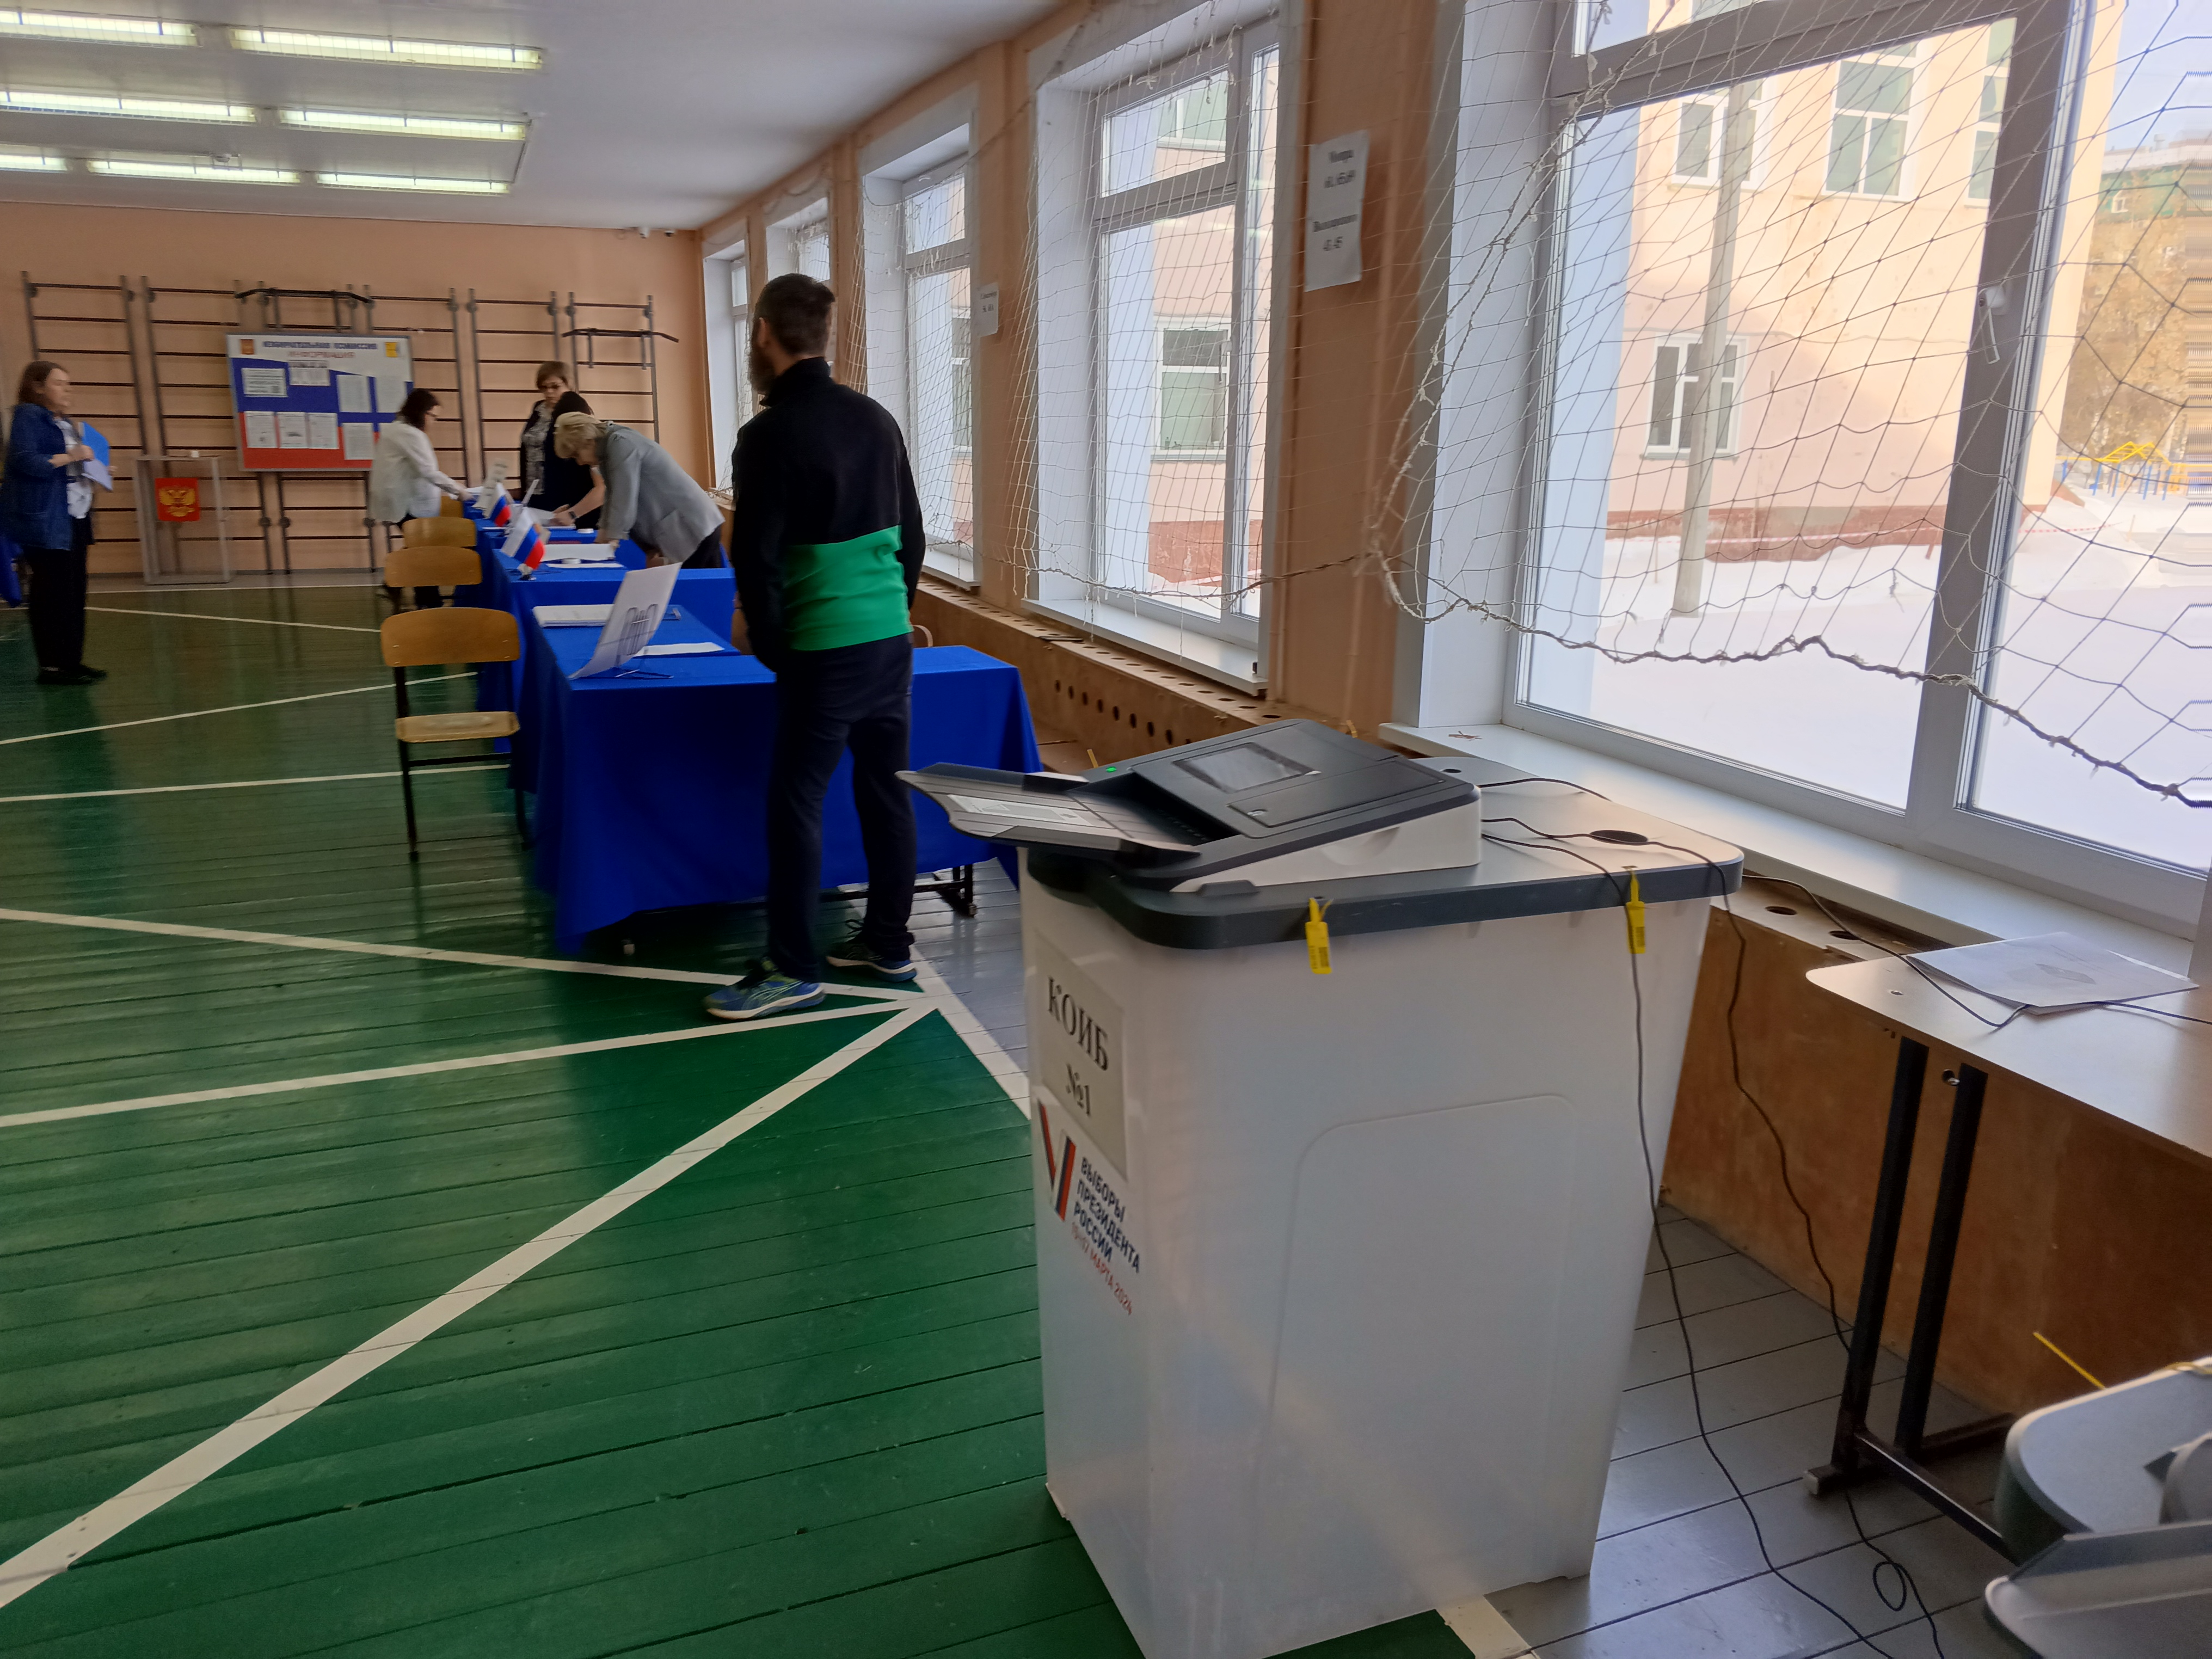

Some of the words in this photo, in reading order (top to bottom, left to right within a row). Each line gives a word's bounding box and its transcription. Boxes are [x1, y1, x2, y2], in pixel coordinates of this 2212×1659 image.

[1048, 976, 1109, 1071] КОИБ
[1065, 1062, 1091, 1116] №1
[1081, 1157, 1126, 1222] ВЫБОРЫ
[1074, 1201, 1113, 1262] РОССИИ
[1077, 1178, 1139, 1273] ПРЕЗИДЕНТА
[1090, 1249, 1113, 1290] МАРТА
[1114, 1283, 1132, 1315] 2024
